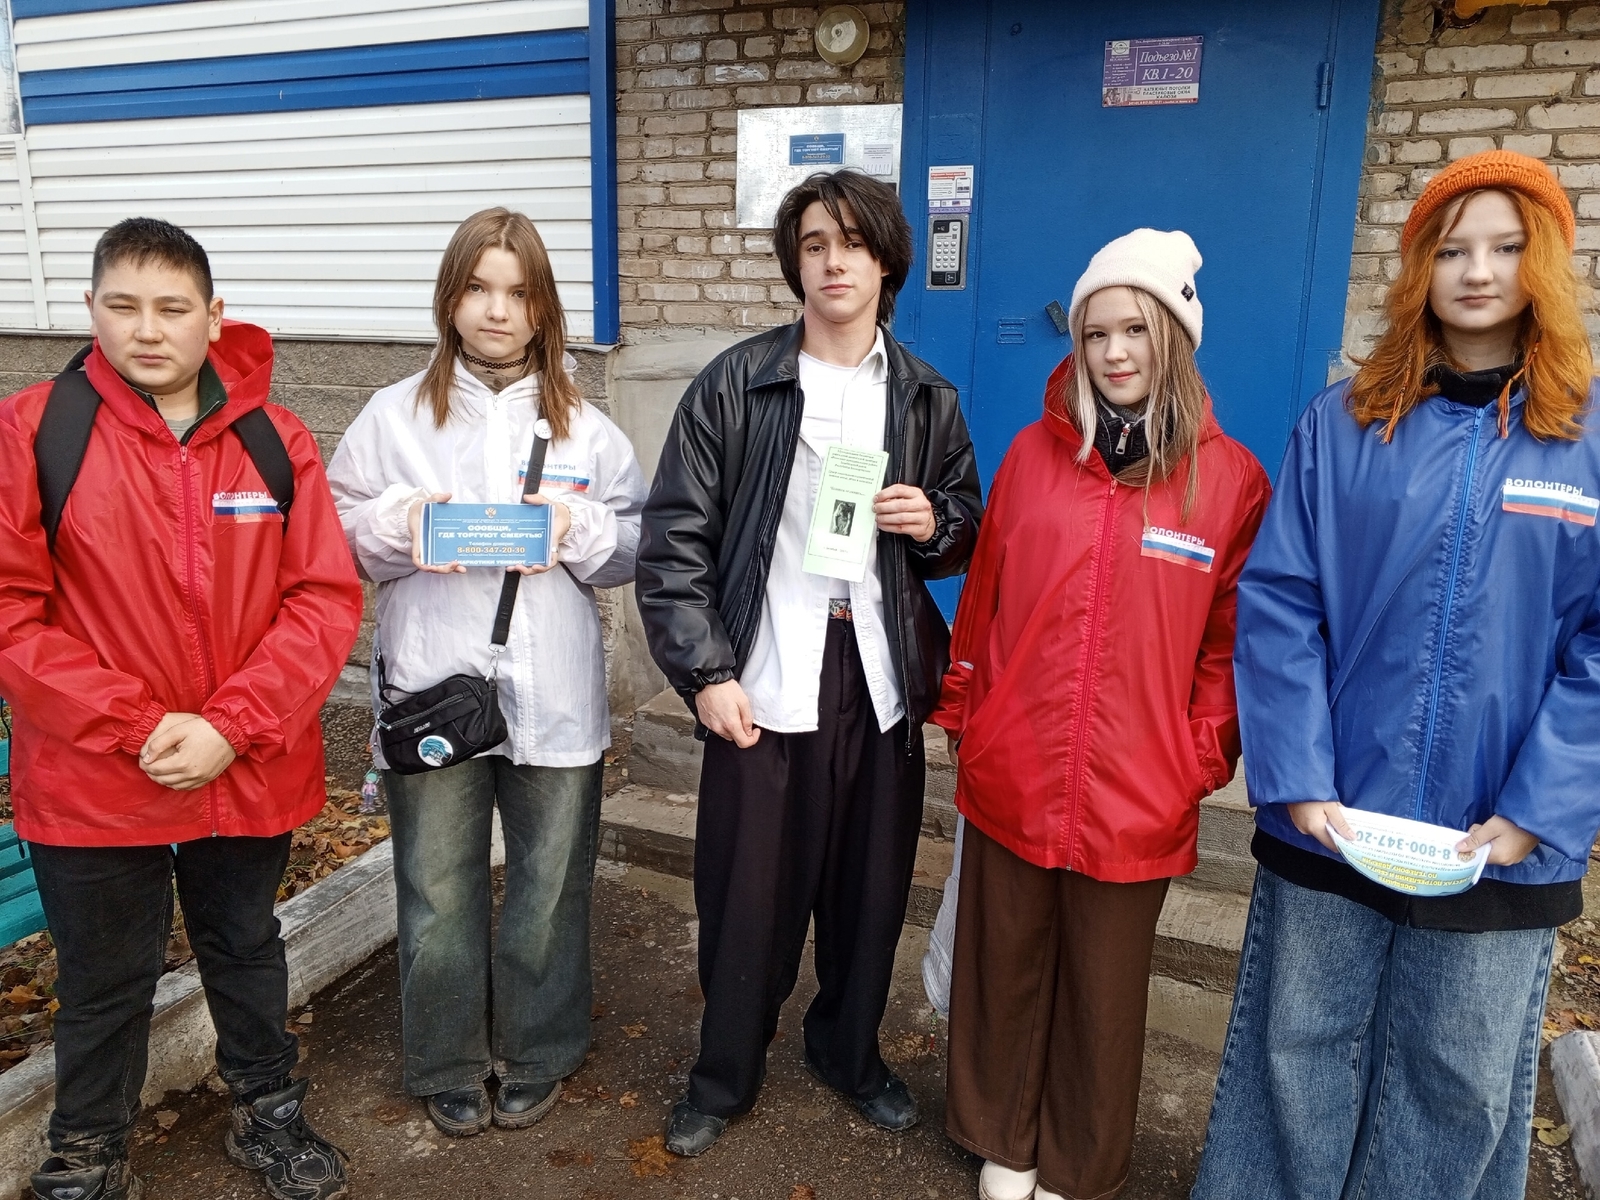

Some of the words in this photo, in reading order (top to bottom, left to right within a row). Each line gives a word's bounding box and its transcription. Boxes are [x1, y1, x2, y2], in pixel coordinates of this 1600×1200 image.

[1139, 50, 1180, 63] Подъезд
[1505, 478, 1584, 496] ВОЛОНТЕРЫ
[457, 546, 526, 554] 8-800-347-20-30
